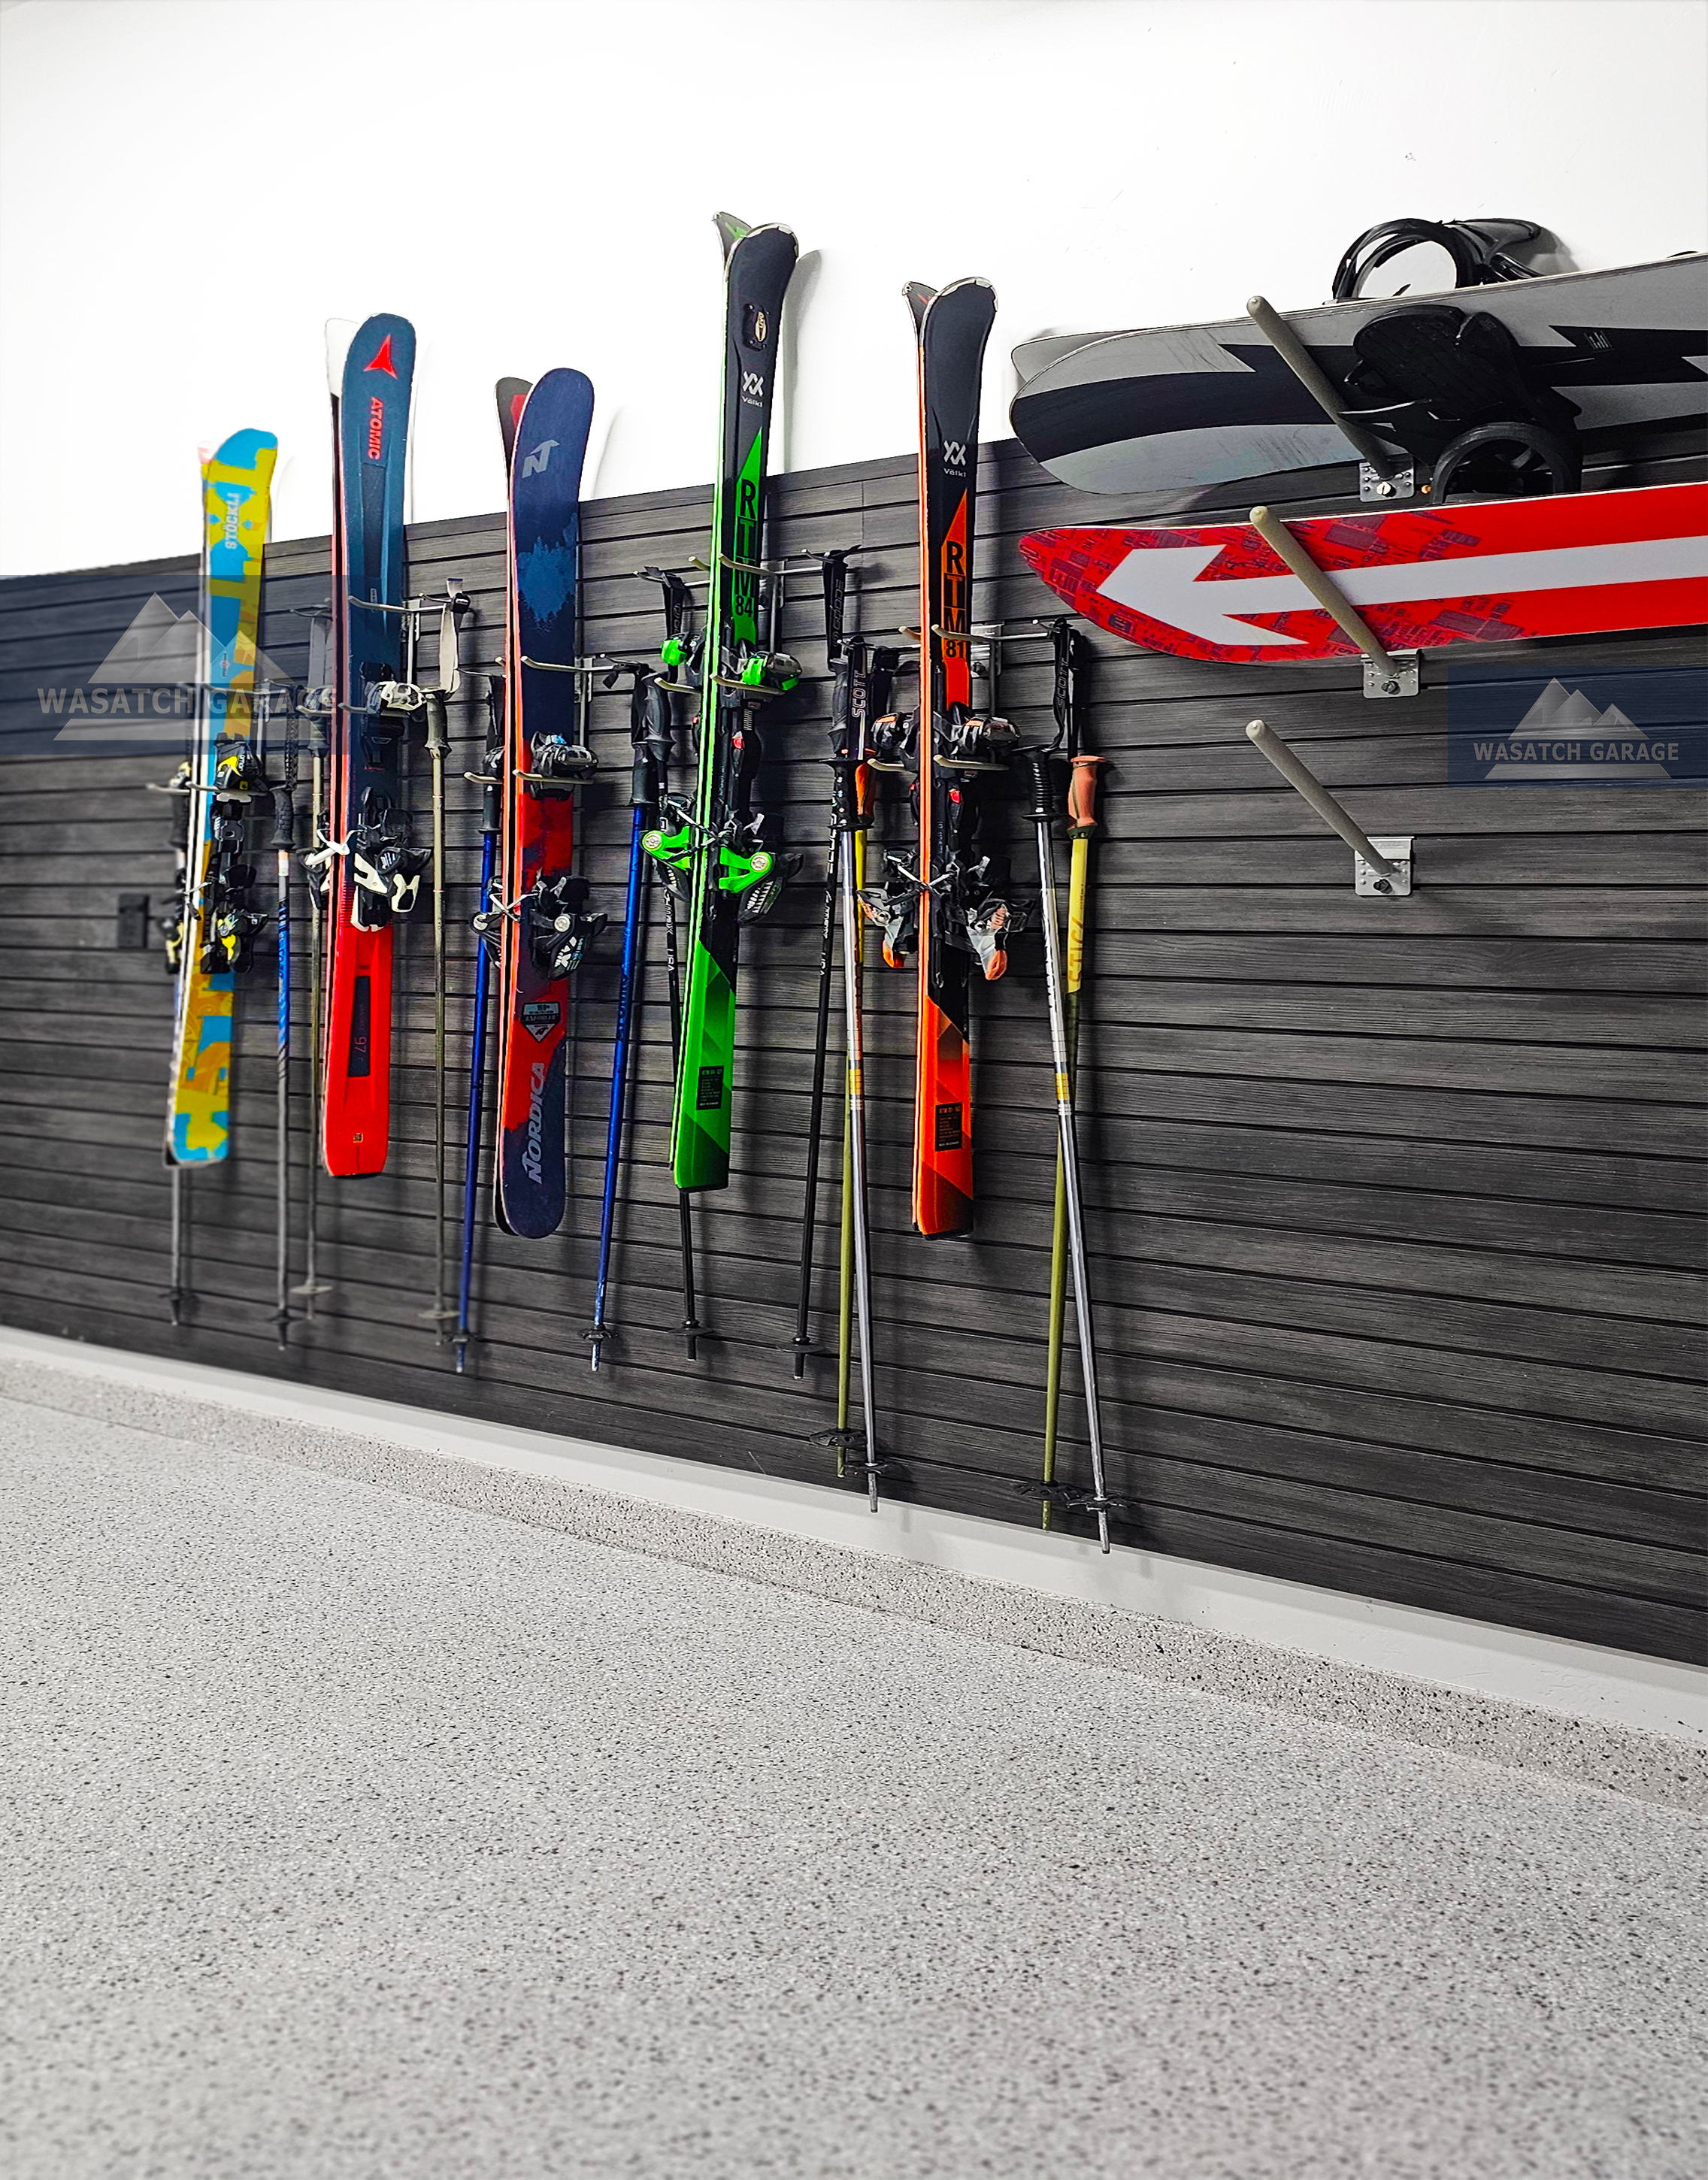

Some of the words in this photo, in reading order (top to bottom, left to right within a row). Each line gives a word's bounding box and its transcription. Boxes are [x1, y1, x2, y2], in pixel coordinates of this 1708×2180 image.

[368, 396, 383, 460] ATOMIC
[734, 595, 753, 617] 84
[946, 640, 965, 659] 81
[851, 670, 867, 718] SCOTT
[1056, 657, 1069, 708] SCOTT
[354, 1036, 367, 1053] 97
[522, 1062, 545, 1185] NORDICA
